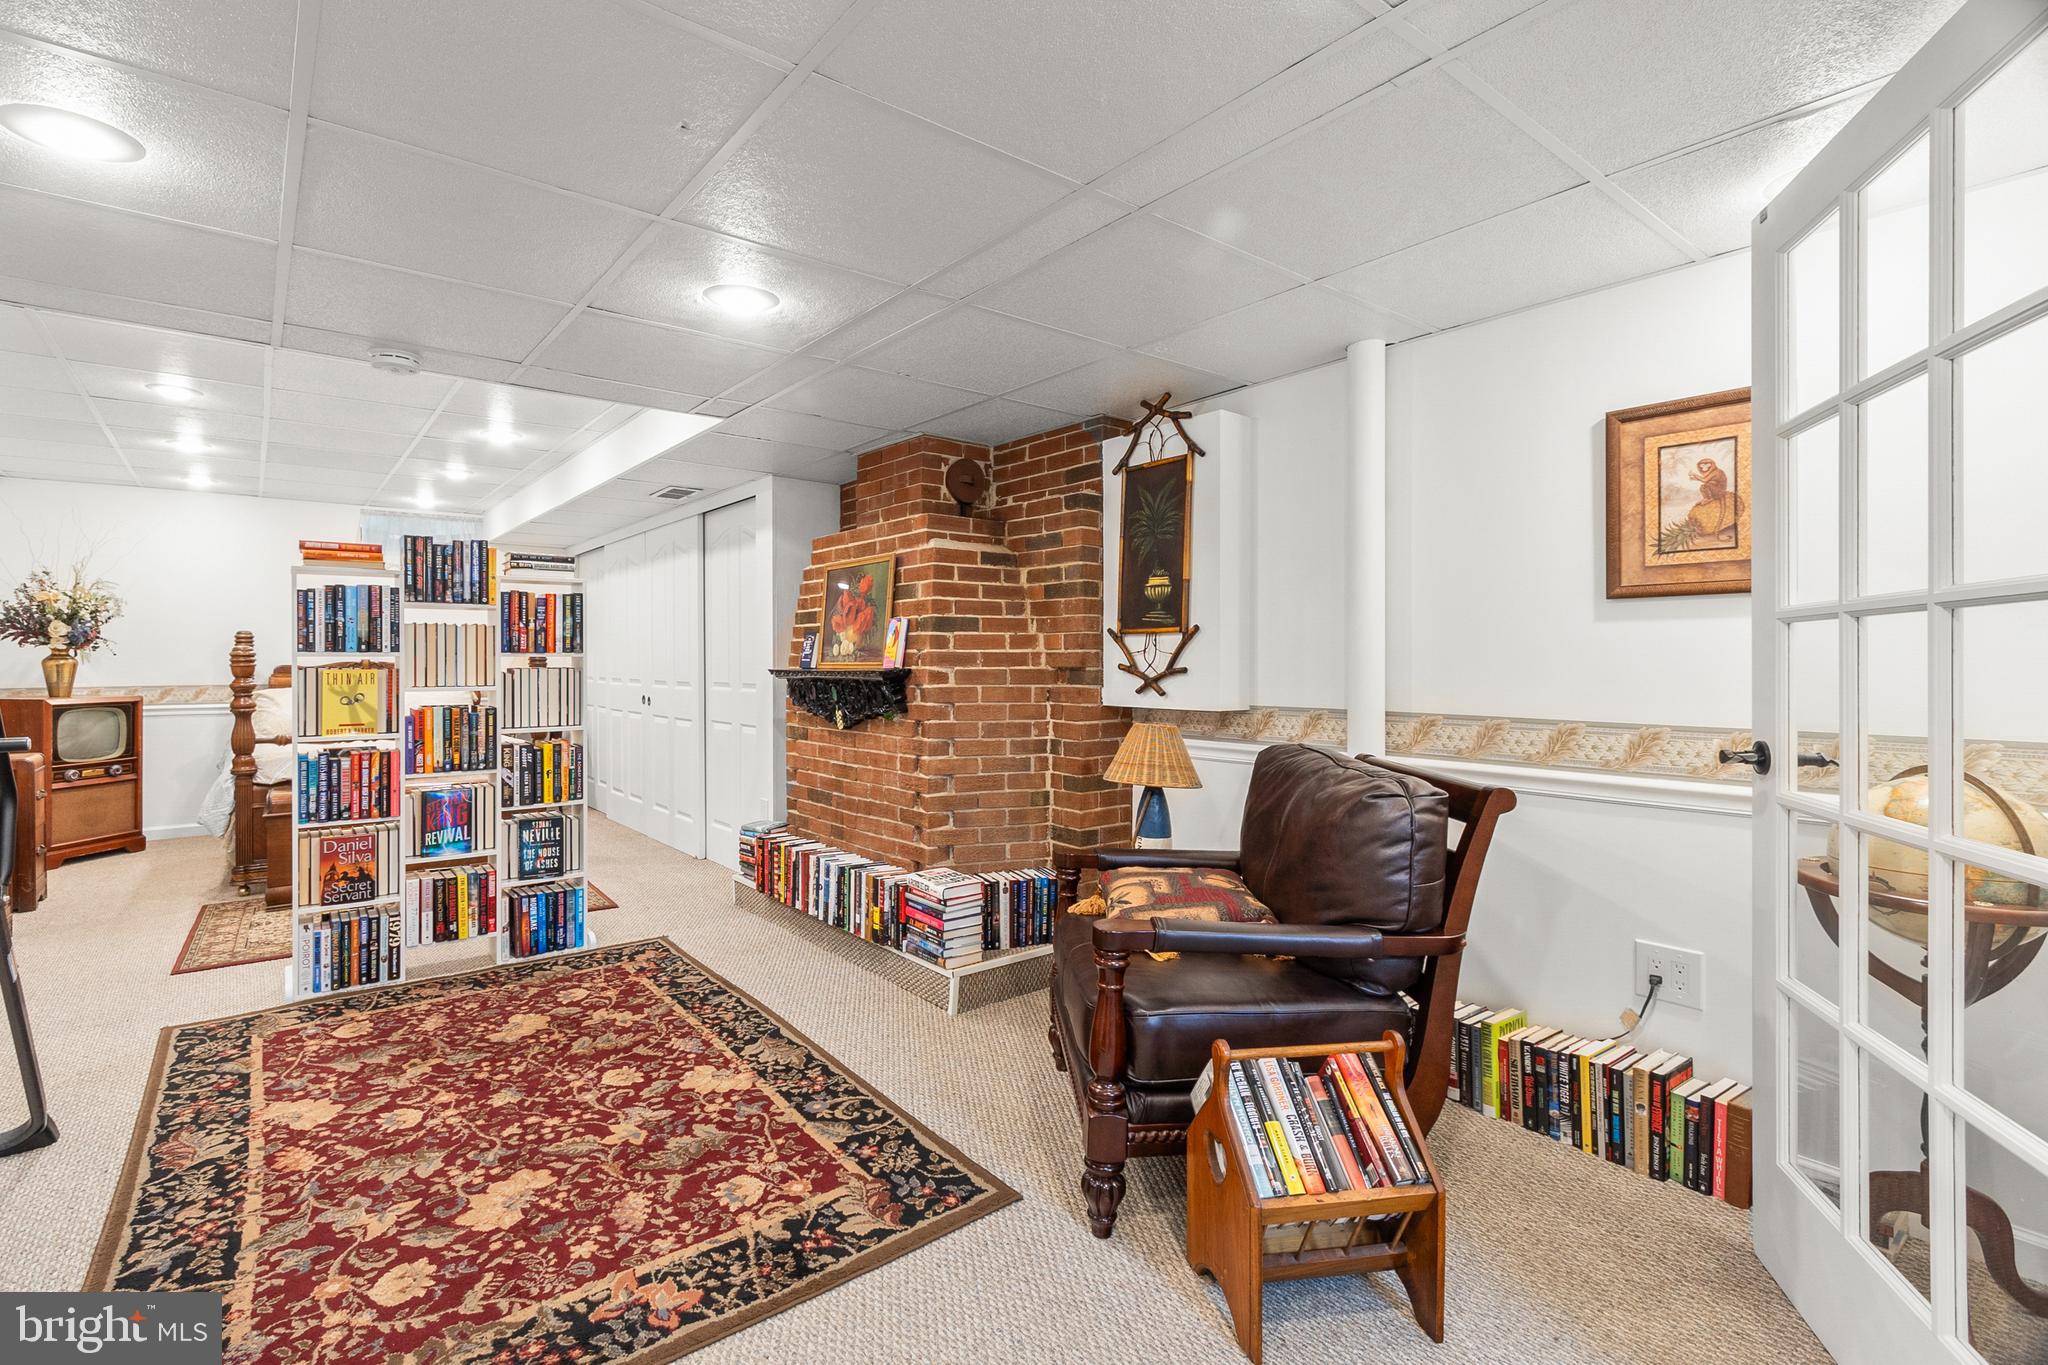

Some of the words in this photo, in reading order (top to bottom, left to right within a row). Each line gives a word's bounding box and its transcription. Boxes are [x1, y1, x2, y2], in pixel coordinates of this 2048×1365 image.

[325, 672, 352, 686] THIN
[357, 672, 376, 685] AIR
[503, 748, 512, 768] KING
[427, 804, 468, 833] KING
[425, 824, 471, 846] REVIVAL
[522, 827, 561, 843] NEVILLE
[323, 836, 372, 854] Daniel
[523, 848, 535, 860] THE
[538, 847, 560, 857] HOUSE
[338, 851, 372, 865] Silva
[524, 860, 534, 871] OF
[536, 858, 559, 869] ASHES
[331, 880, 372, 894] Secret
[323, 890, 372, 904] Servant
[530, 897, 538, 915] MOON
[388, 916, 401, 948] 1979
[530, 916, 538, 931] LAKE
[302, 939, 310, 970] POIROT
[1459, 1034, 1469, 1052] ISIS
[1559, 1061, 1569, 1083] WHITE
[1510, 1057, 1520, 1110] SILVERWOOD
[1559, 1083, 1569, 1104] TIGER
[1236, 1105, 1254, 1145] MONRO
[1263, 1060, 1276, 1077] LISA
[1270, 1077, 1290, 1111] GARDNER
[1286, 1114, 1301, 1142] CRASH
[1300, 1152, 1319, 1177] BURN
[1338, 1108, 1350, 1130] ANIMAL
[1347, 1132, 1356, 1147] FARM
[1313, 1125, 1324, 1140] GHOST
